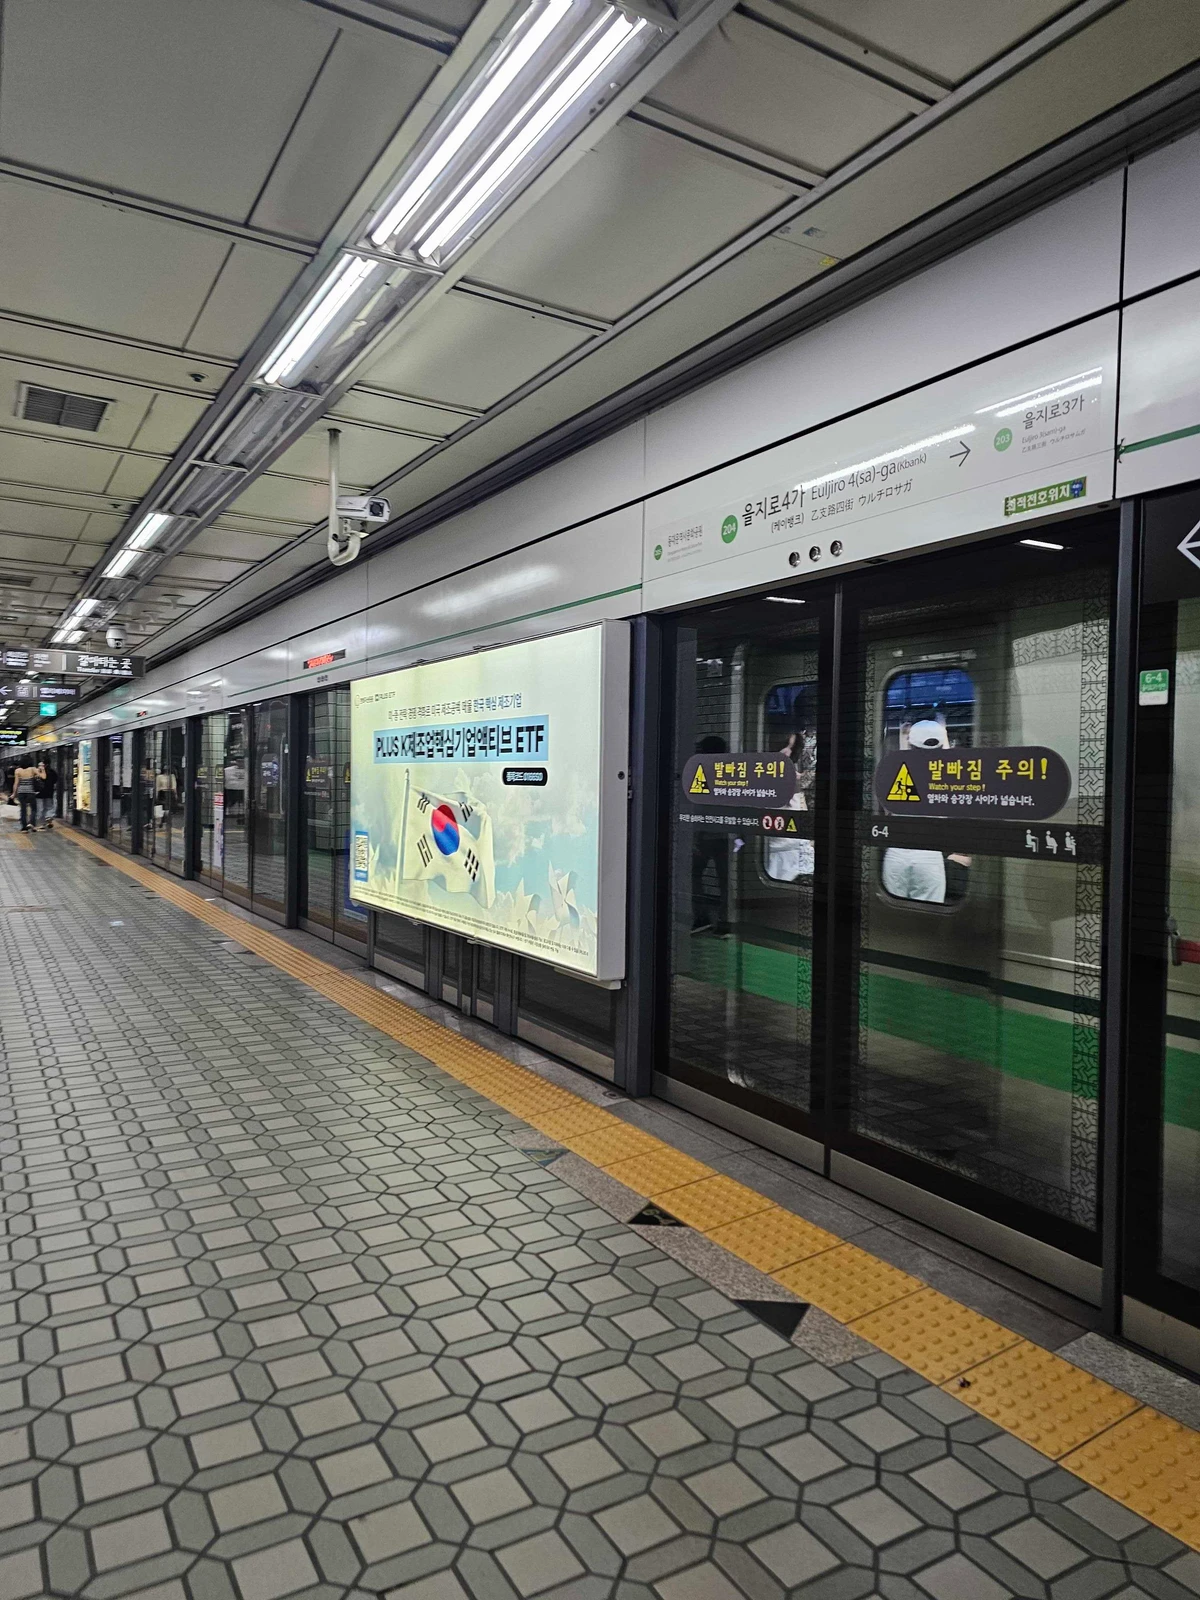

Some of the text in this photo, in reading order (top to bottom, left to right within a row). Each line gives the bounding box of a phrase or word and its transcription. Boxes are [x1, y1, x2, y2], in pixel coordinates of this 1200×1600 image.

[1022, 394, 1085, 430] 을지로3가
[995, 434, 1010, 446] 203
[811, 478, 846, 501] Euljiro
[741, 485, 806, 527] 을지로4가
[811, 478, 914, 522] 乙支路四街 ウルチロサガ
[722, 522, 737, 536] 204
[771, 512, 804, 534] (케이뱅크)
[1145, 672, 1163, 683] 6-4
[498, 693, 522, 709] 제조기업
[376, 724, 545, 759] PLUS K제조업핵심기업액티브 ETF
[714, 761, 785, 778] 발빠짐 주의!
[928, 757, 1048, 781] 발빠짐 주의!
[928, 783, 949, 791] Watch
[950, 784, 965, 792] your
[927, 793, 1035, 806] 열차와 승강장 사이가 넓습니다.
[871, 825, 889, 838] 6-4
